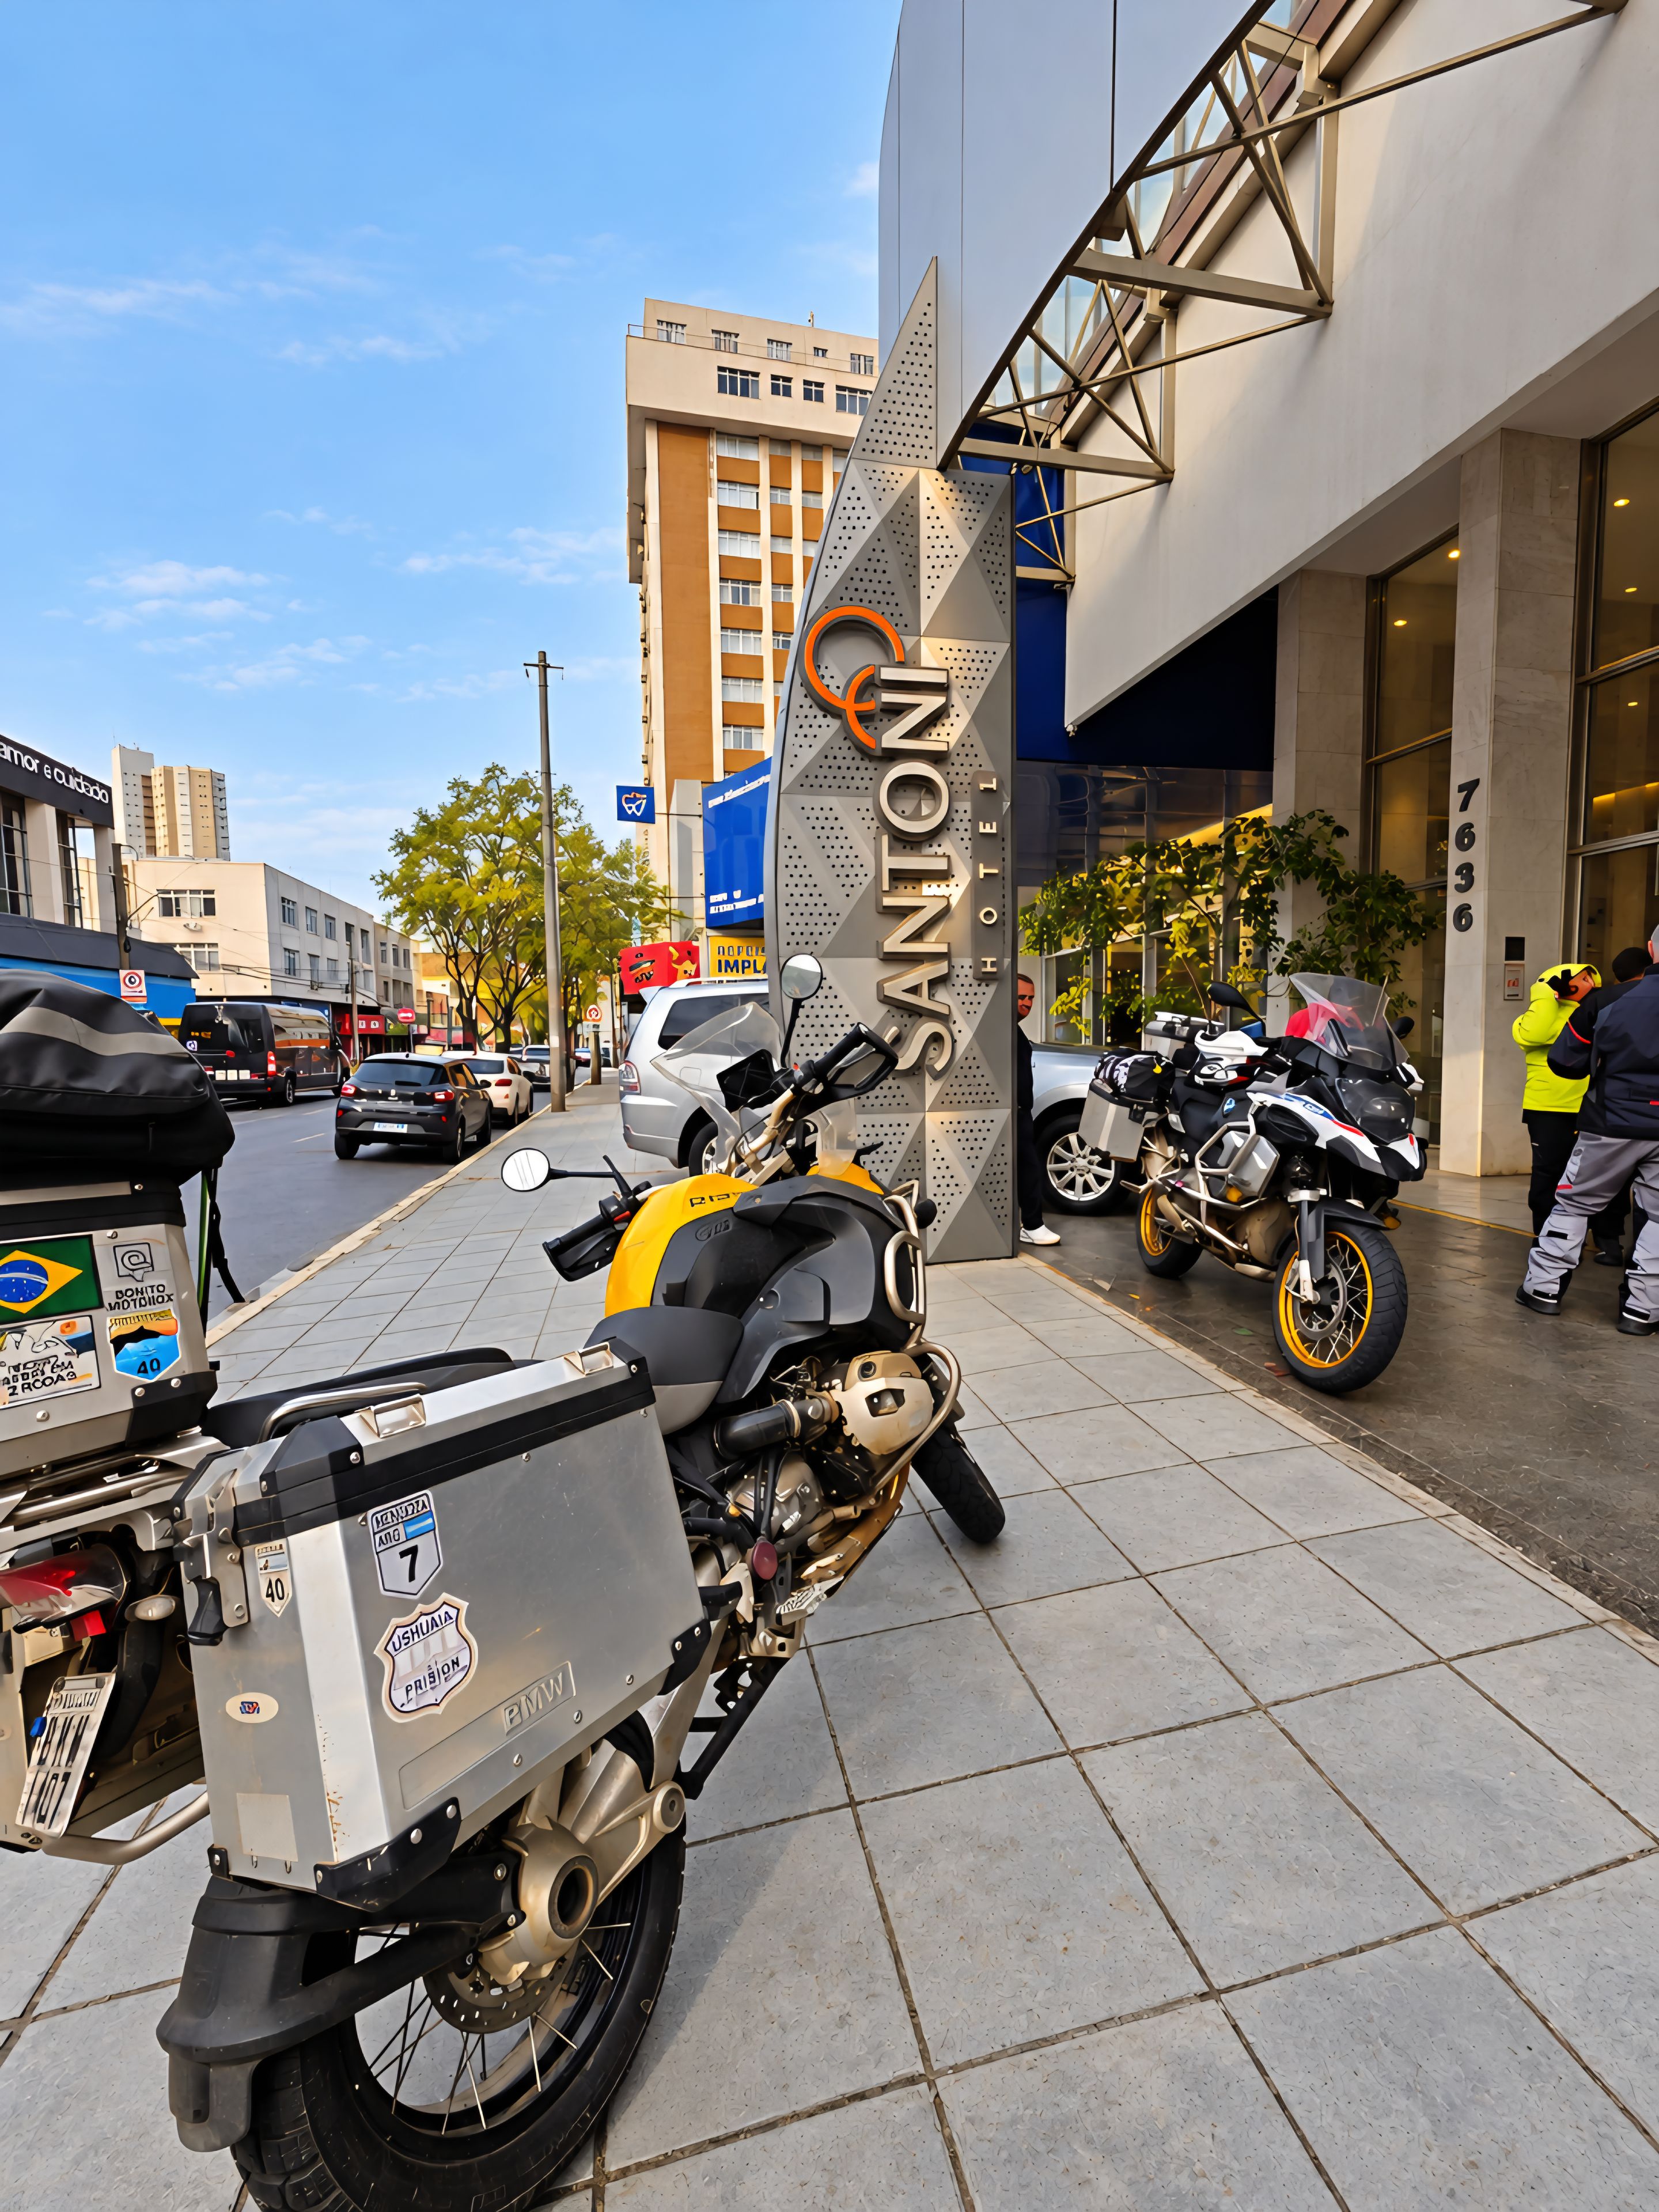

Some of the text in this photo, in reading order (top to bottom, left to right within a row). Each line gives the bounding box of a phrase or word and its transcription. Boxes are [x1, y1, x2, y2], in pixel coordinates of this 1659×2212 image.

[878, 665, 953, 1073] SANTONI
[979, 777, 997, 973] HOTEL
[1452, 778, 1480, 933] 7636
[266, 1577, 285, 1603] 40
[399, 1544, 418, 1582] 7
[392, 1611, 453, 1652] USHUAIA
